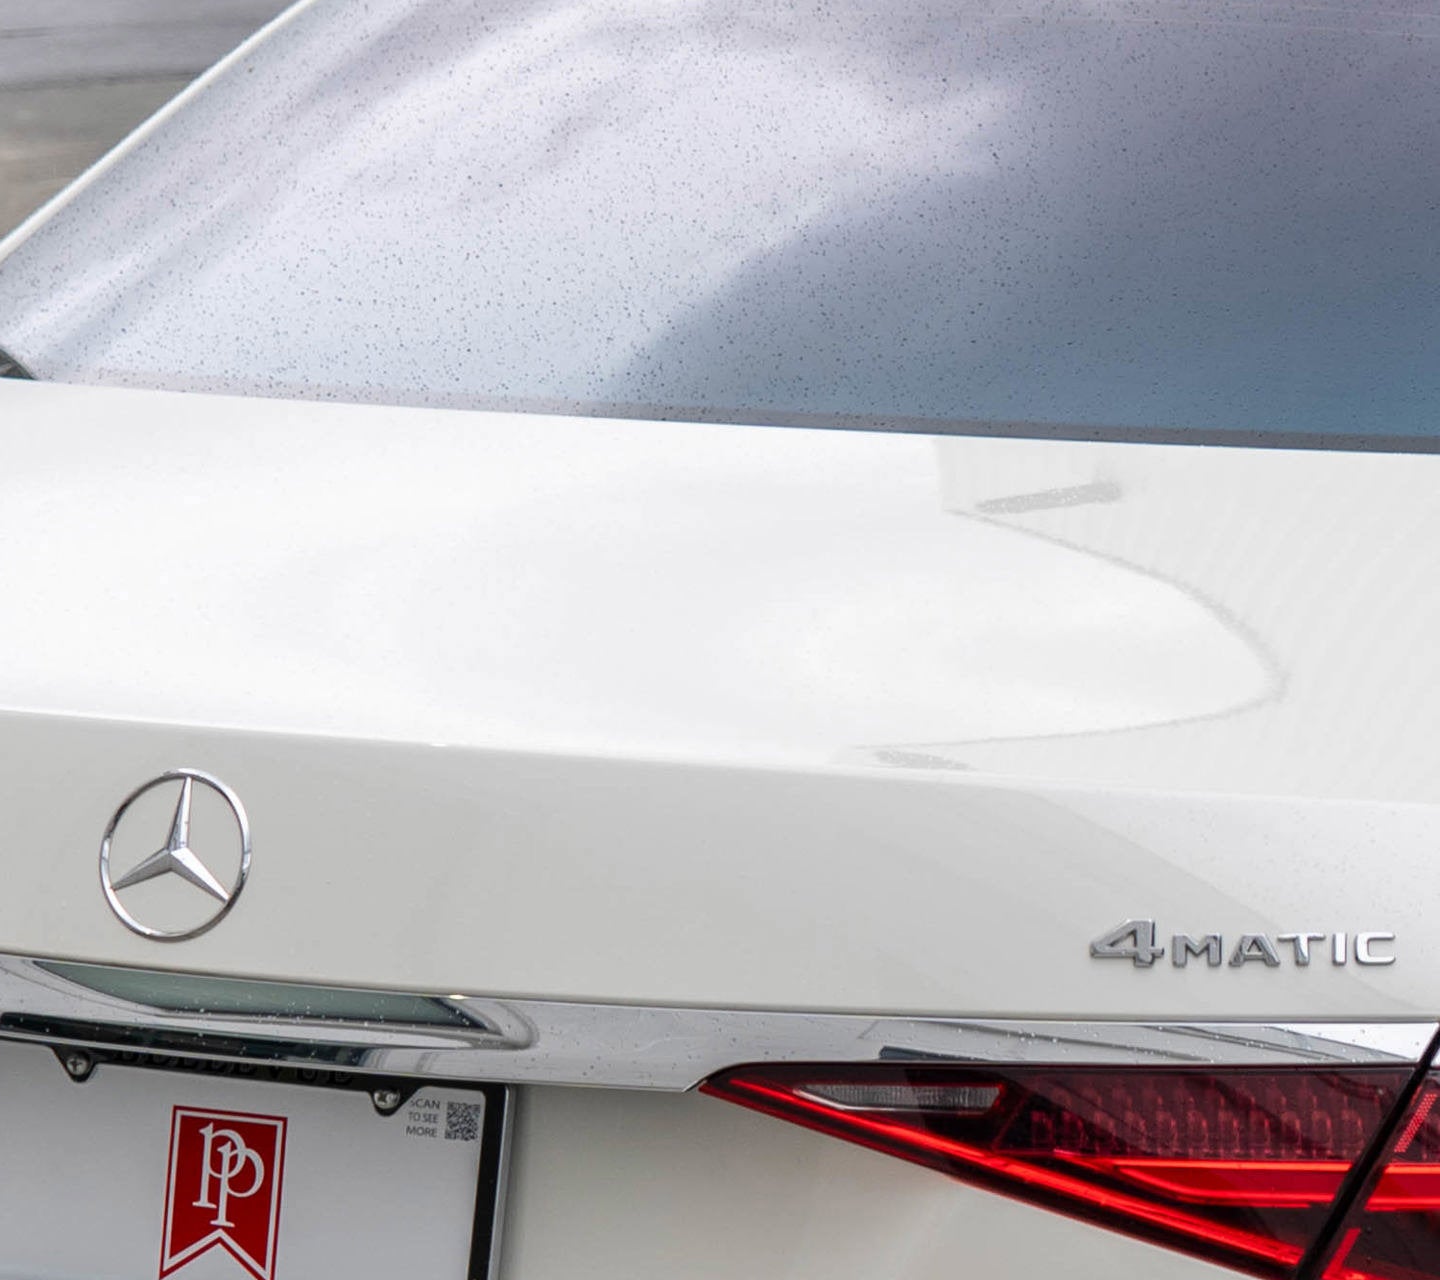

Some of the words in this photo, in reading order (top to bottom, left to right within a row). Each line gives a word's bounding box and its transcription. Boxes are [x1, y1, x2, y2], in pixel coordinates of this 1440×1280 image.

[1089, 917, 1396, 967] 4MATIC
[408, 1111, 421, 1122] TO
[423, 1113, 439, 1124] SEE
[405, 1126, 437, 1138] MORE
